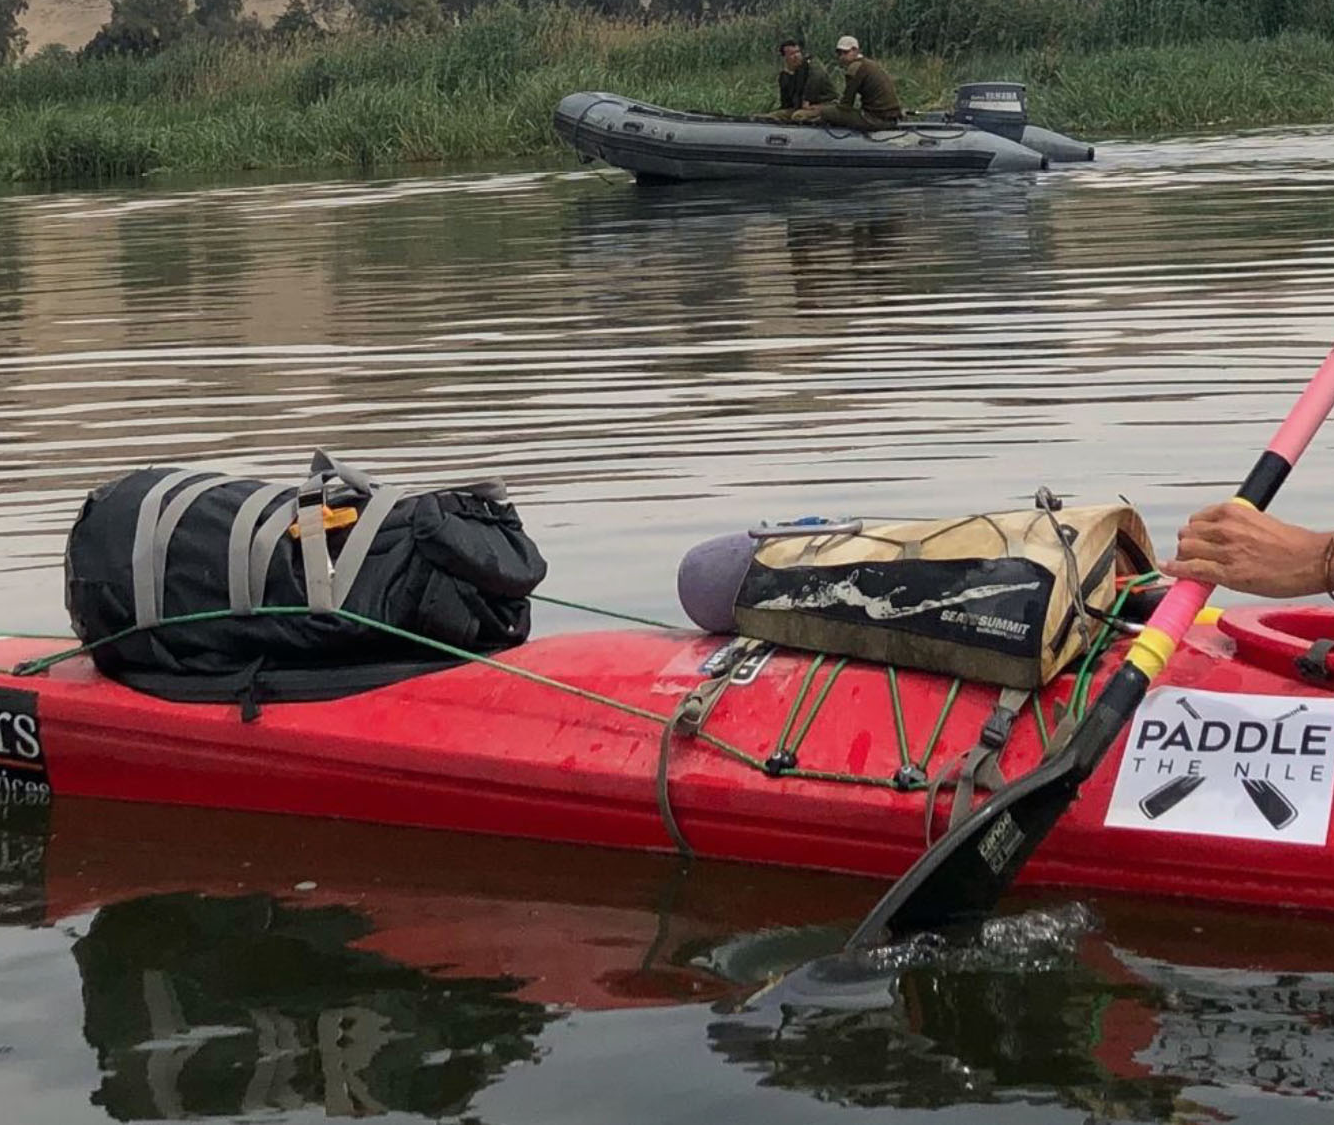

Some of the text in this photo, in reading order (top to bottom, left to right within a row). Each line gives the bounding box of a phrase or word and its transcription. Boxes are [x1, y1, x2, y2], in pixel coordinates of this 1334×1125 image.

[940, 609, 964, 625] SEA
[978, 615, 1030, 635] SUMMIT
[1135, 720, 1332, 755] PADDLE
[1133, 757, 1325, 782] THE NILE
